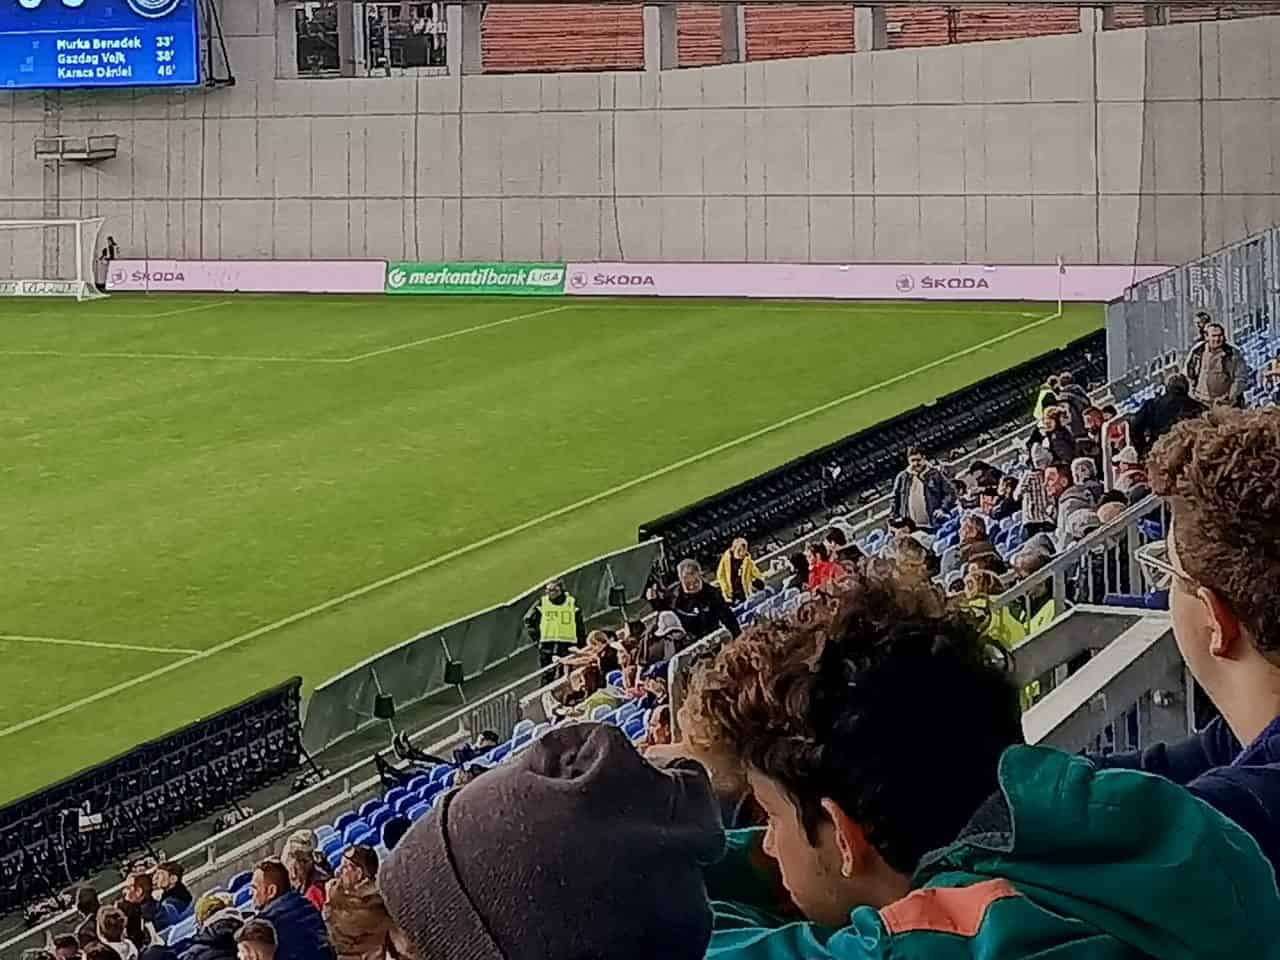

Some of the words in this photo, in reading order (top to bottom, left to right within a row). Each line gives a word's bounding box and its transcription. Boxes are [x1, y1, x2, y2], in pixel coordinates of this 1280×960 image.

[57, 38, 90, 50] Murka
[93, 36, 142, 49] Benedek
[57, 52, 99, 65] Gazdag
[409, 267, 528, 286] merkantilbank
[593, 272, 655, 286] ŠKODA
[920, 275, 990, 289] ŠKODA
